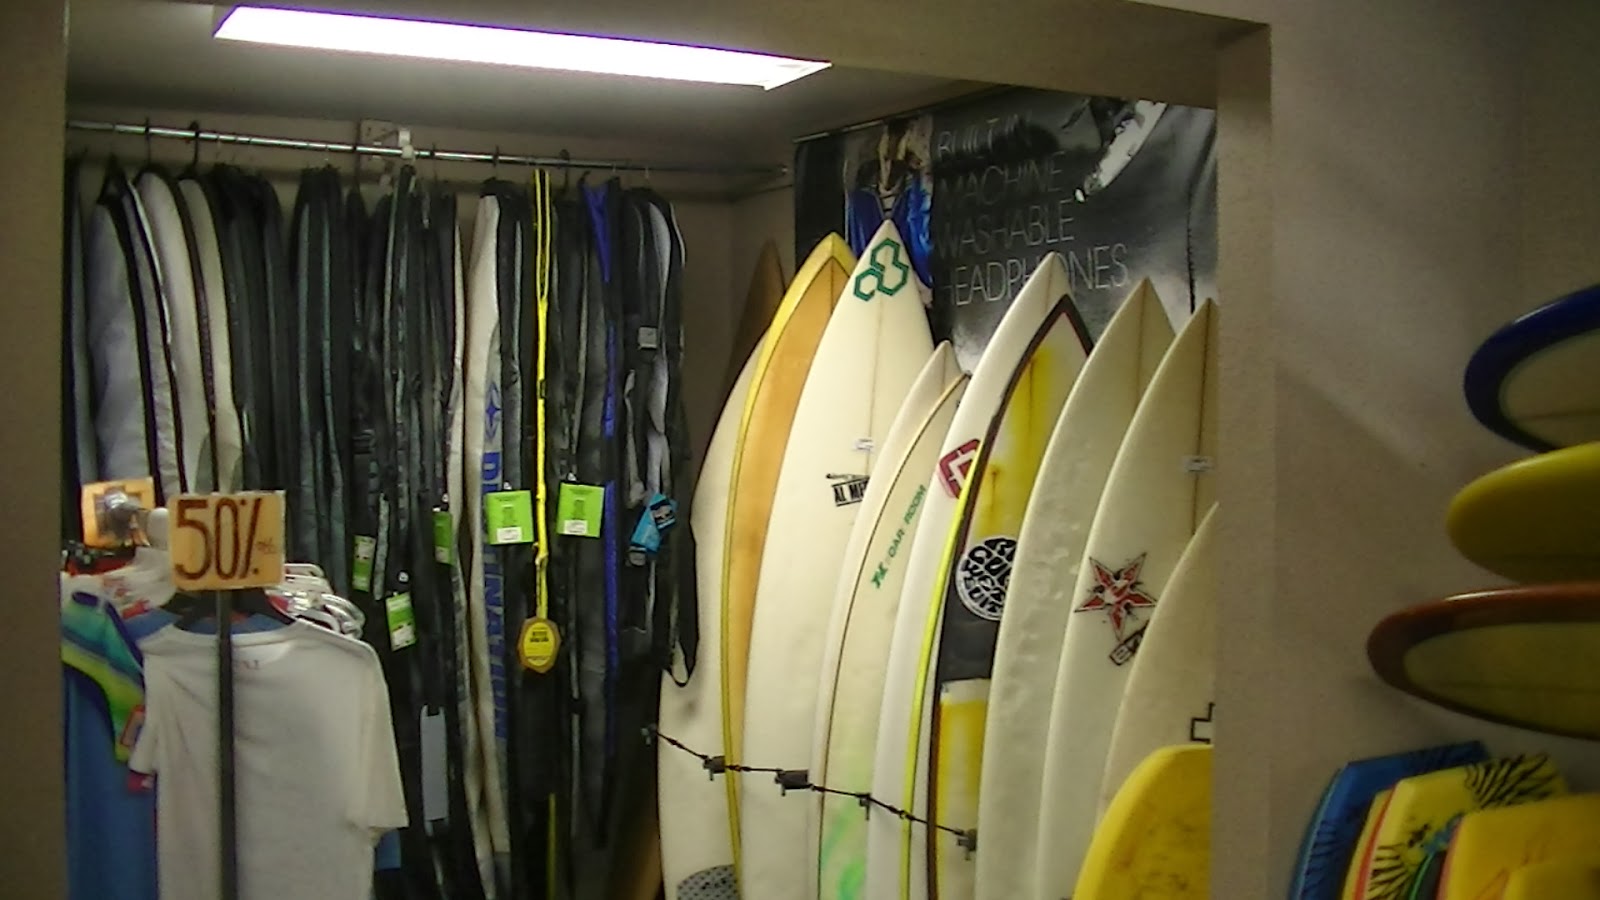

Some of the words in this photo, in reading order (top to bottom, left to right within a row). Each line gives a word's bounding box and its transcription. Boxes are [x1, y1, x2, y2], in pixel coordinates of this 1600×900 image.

[937, 150, 1067, 211] MACHINE
[936, 198, 1075, 259] WASHABLE
[175, 498, 262, 580] 50%
